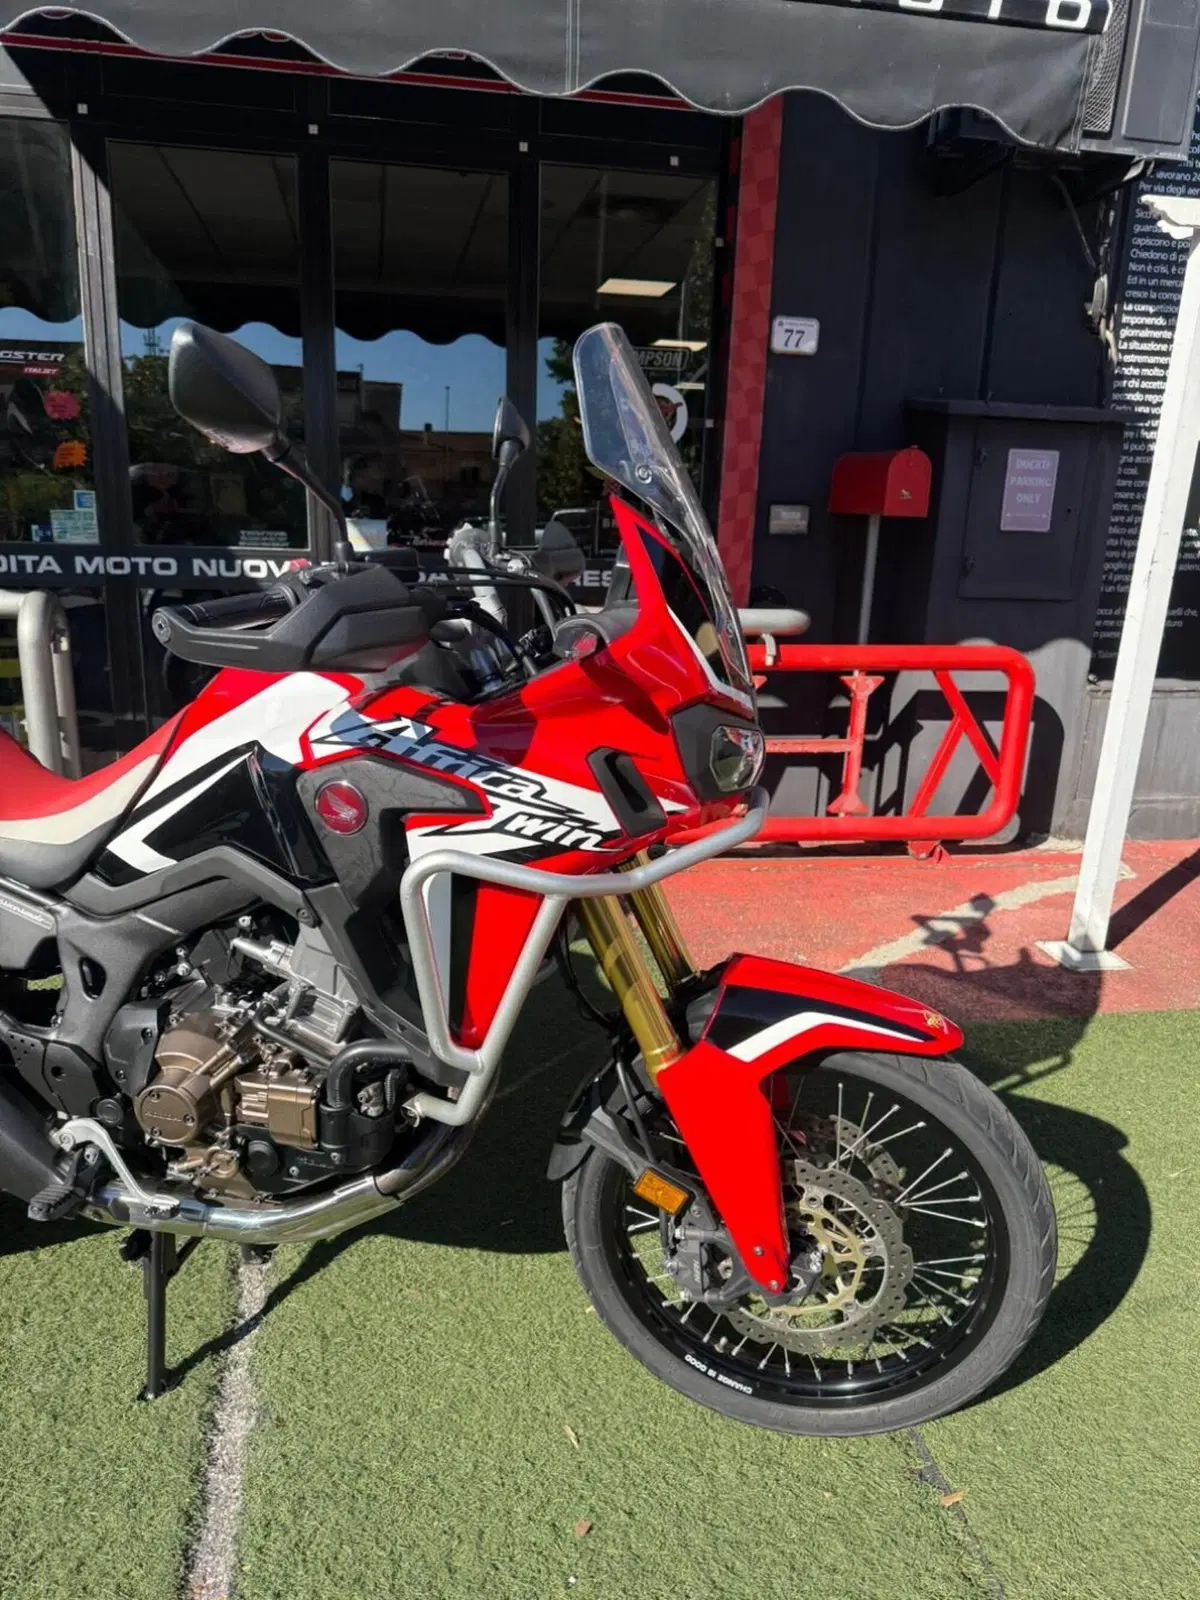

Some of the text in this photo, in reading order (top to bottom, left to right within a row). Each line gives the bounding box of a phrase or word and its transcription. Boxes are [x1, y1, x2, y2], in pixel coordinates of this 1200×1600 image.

[1165, 183, 1186, 197] degli
[1131, 236, 1170, 248] capiscono
[1170, 240, 1177, 248] e
[1130, 248, 1168, 260] Chiedono
[1169, 251, 1178, 261] di
[1128, 262, 1146, 272] Non
[1126, 275, 1138, 285] Ed
[1139, 276, 1147, 285] in
[1148, 278, 1159, 286] un
[1125, 290, 1148, 298] cresce
[1149, 289, 1157, 299] la
[1123, 302, 1133, 311] La
[784, 329, 805, 348] 77
[1119, 327, 1172, 339] giornalmente
[1118, 340, 1128, 350] La
[1129, 340, 1169, 351] situazione
[1141, 366, 1164, 376] molto
[1009, 475, 1053, 487] PARKING
[1015, 492, 1042, 504] ONLY
[74, 555, 178, 576] MOTO
[192, 558, 311, 579] NUOV
[684, 1353, 754, 1395] CHANGE IS GOOD
